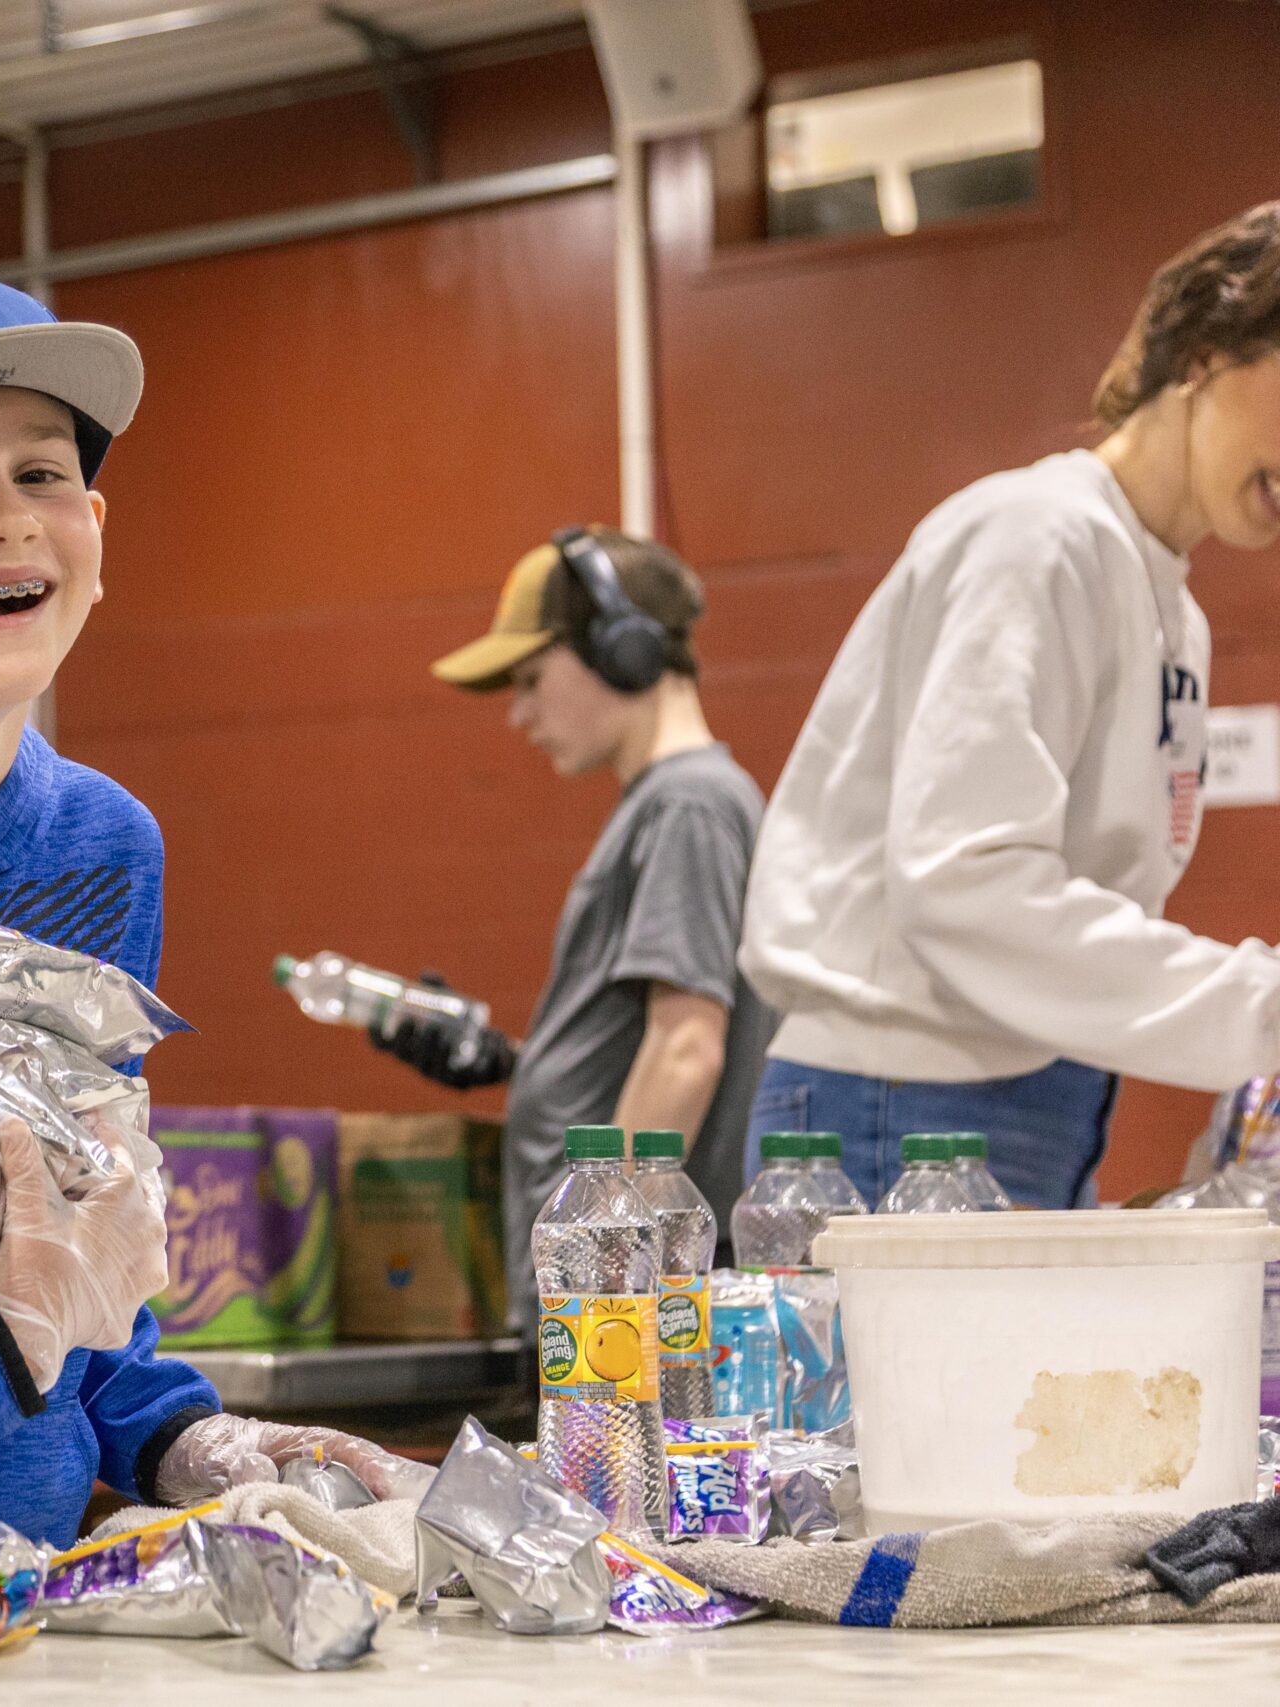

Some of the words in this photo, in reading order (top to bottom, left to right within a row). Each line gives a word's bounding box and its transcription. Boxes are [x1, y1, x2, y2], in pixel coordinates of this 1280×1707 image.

[658, 1303, 696, 1326] Poland
[659, 1316, 699, 1340] Spring
[542, 1345, 573, 1368] Spring
[546, 1361, 571, 1376] ORANGE
